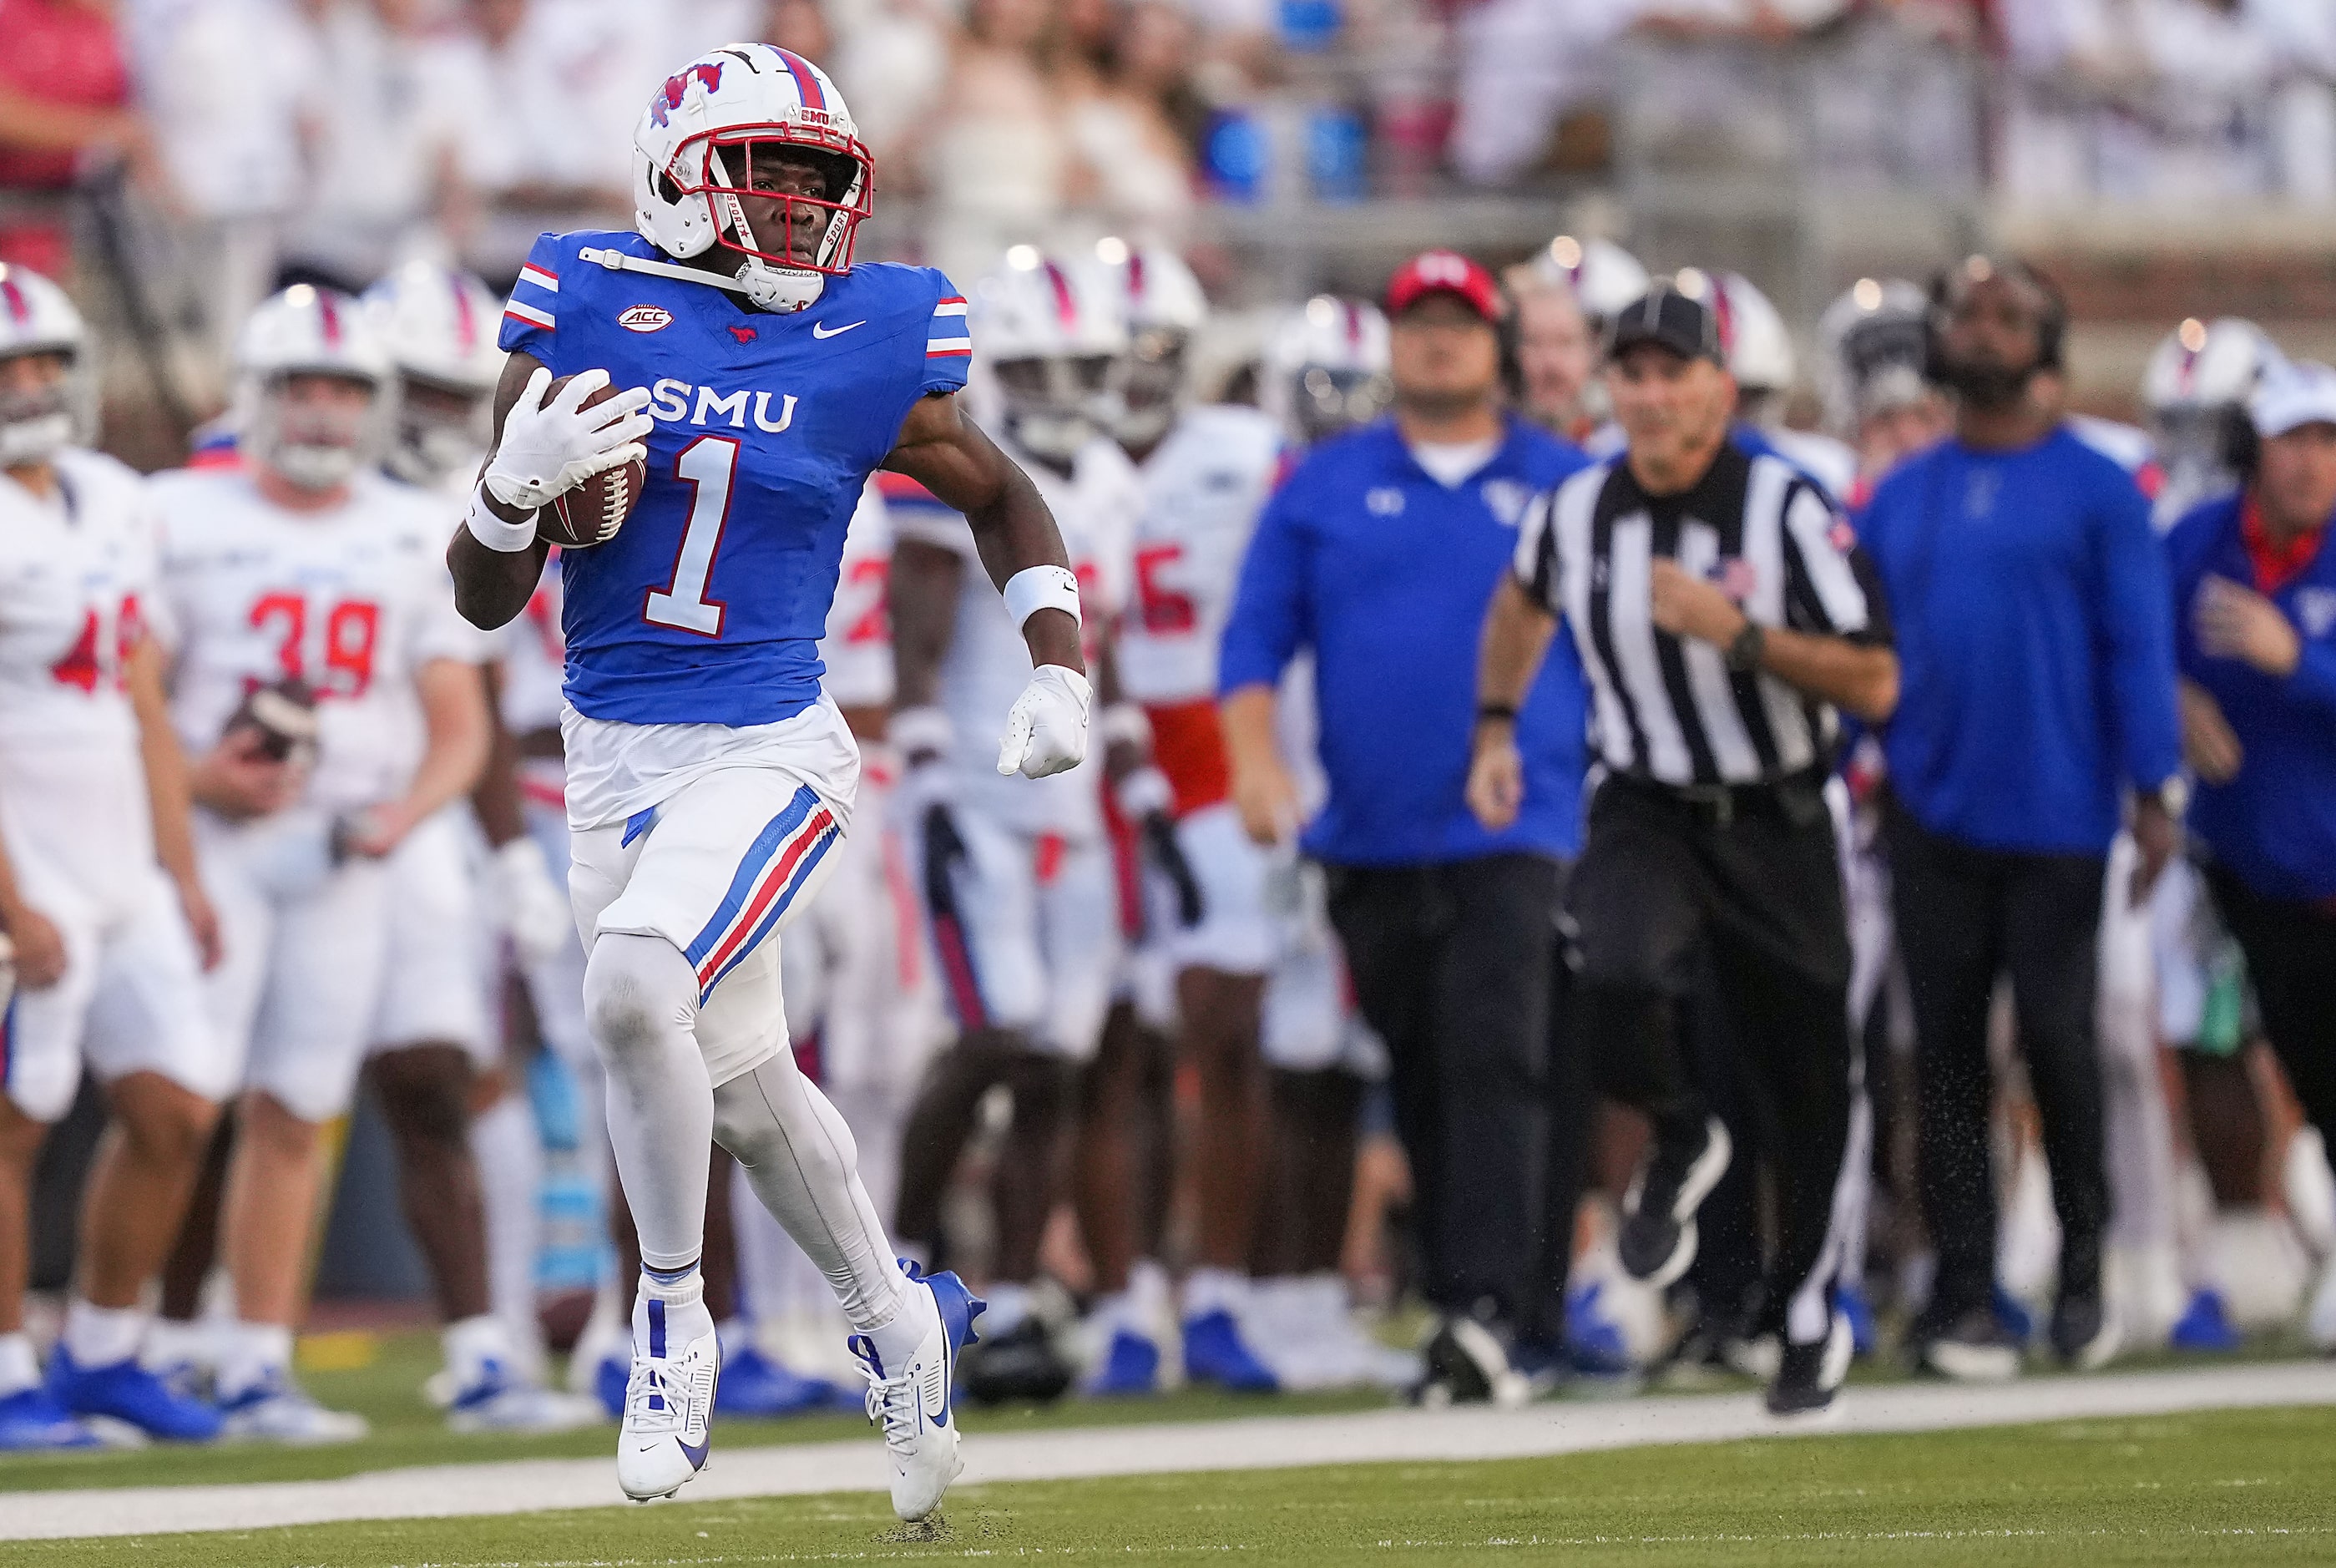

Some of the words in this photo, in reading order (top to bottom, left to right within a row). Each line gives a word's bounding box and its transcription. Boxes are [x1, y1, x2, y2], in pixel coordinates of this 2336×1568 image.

[801, 109, 829, 125] SMU
[625, 311, 666, 322] ACC
[647, 378, 798, 433] SMU
[641, 435, 741, 640] 1
